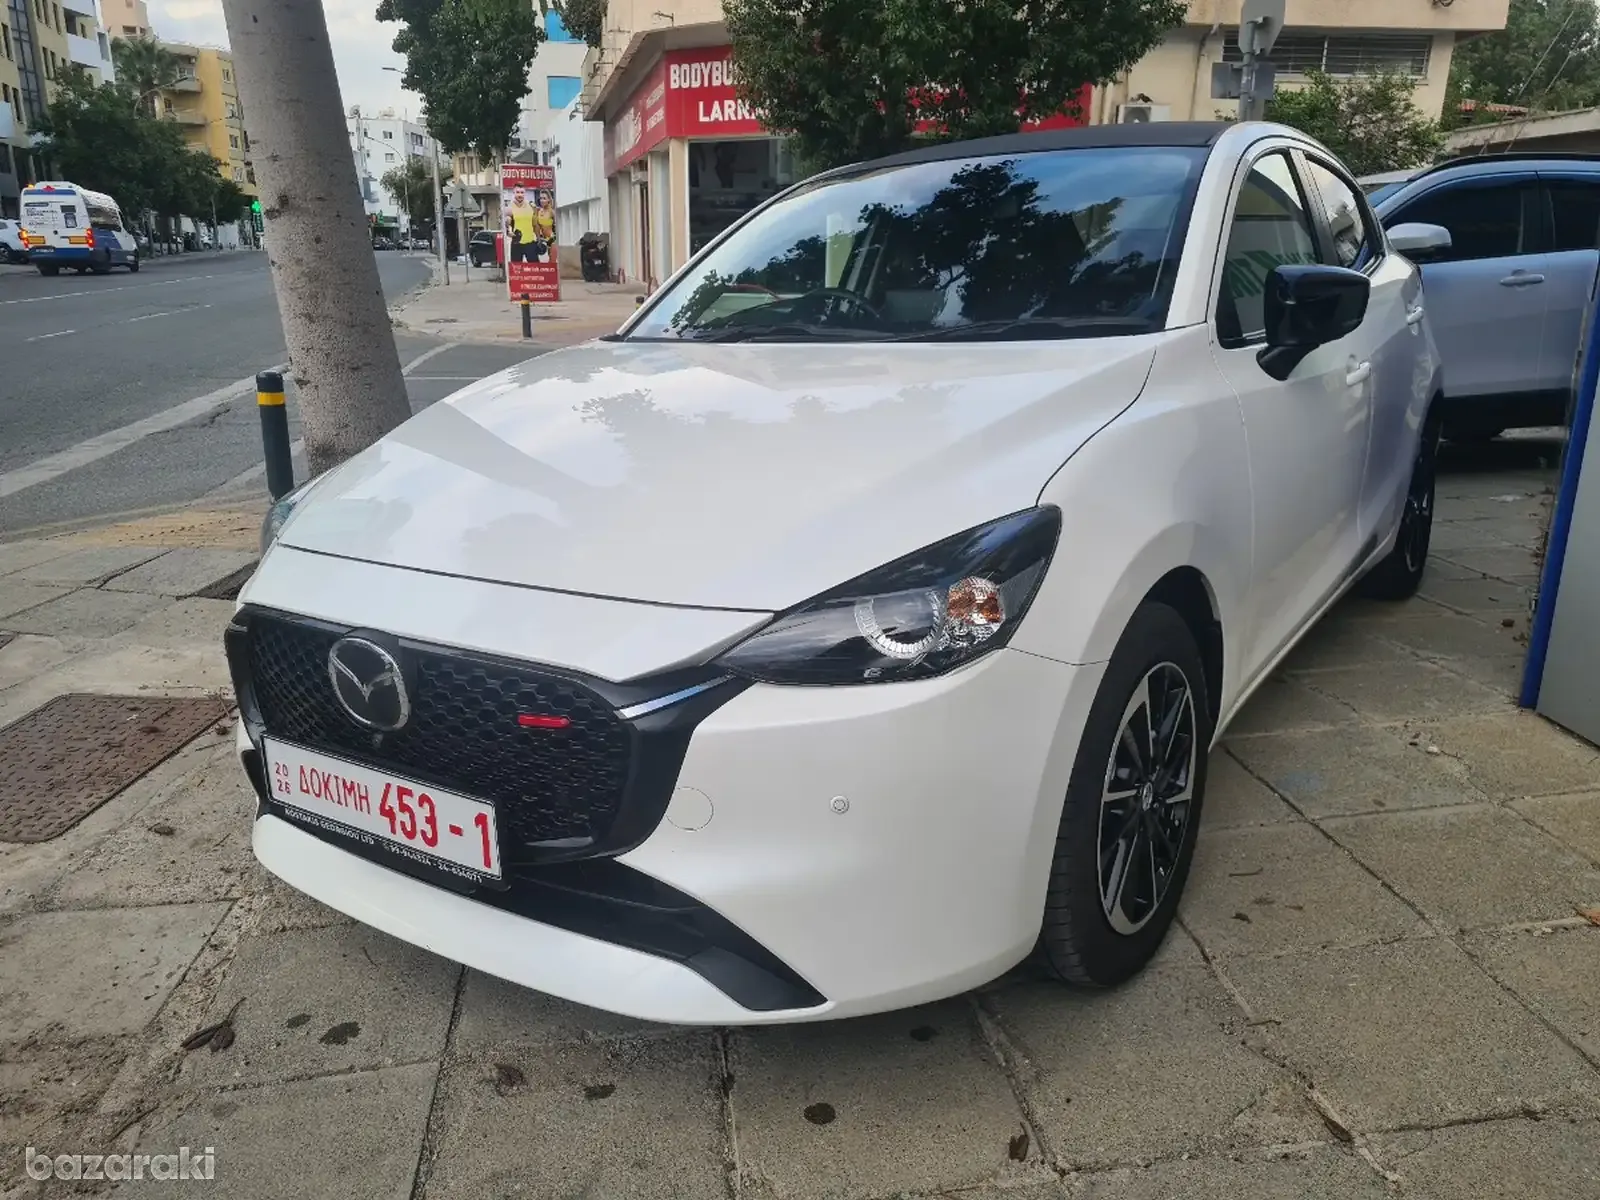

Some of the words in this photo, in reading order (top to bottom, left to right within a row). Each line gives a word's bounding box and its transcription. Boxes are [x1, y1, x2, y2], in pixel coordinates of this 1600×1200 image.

[669, 59, 747, 89] BODYBU
[698, 98, 770, 122] LARN
[502, 168, 553, 180] BODYBUILDING
[274, 761, 289, 777] 20
[276, 779, 292, 796] 26
[299, 764, 371, 815] ΔΟΚΙΜΗ
[378, 782, 439, 848] 453
[473, 811, 492, 869] 1
